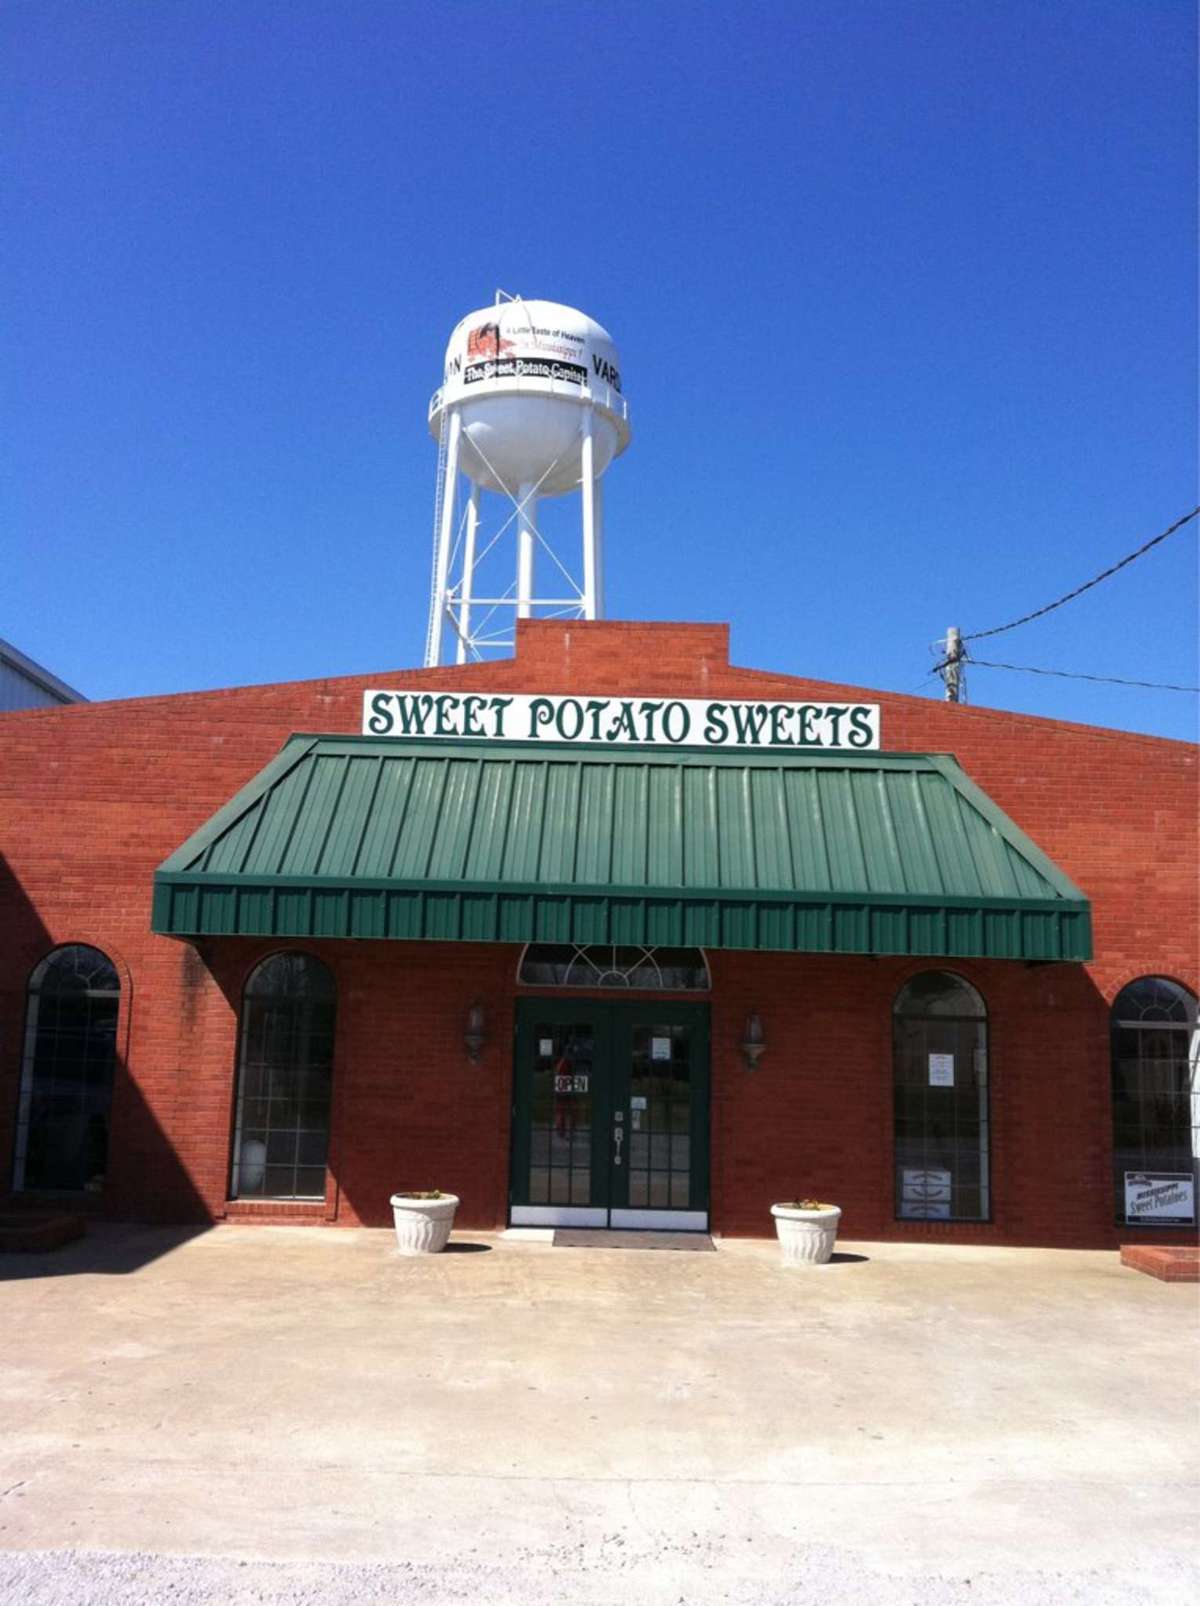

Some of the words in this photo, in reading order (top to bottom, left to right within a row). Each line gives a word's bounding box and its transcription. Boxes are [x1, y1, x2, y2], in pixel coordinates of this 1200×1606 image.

[552, 329, 561, 337] of
[466, 366, 484, 382] The
[484, 362, 514, 380] Sweet
[515, 360, 550, 377] Potato
[551, 363, 586, 385] Capital
[368, 693, 514, 738] SWEET
[527, 698, 692, 742] POTATO
[703, 703, 875, 749] SWEETS
